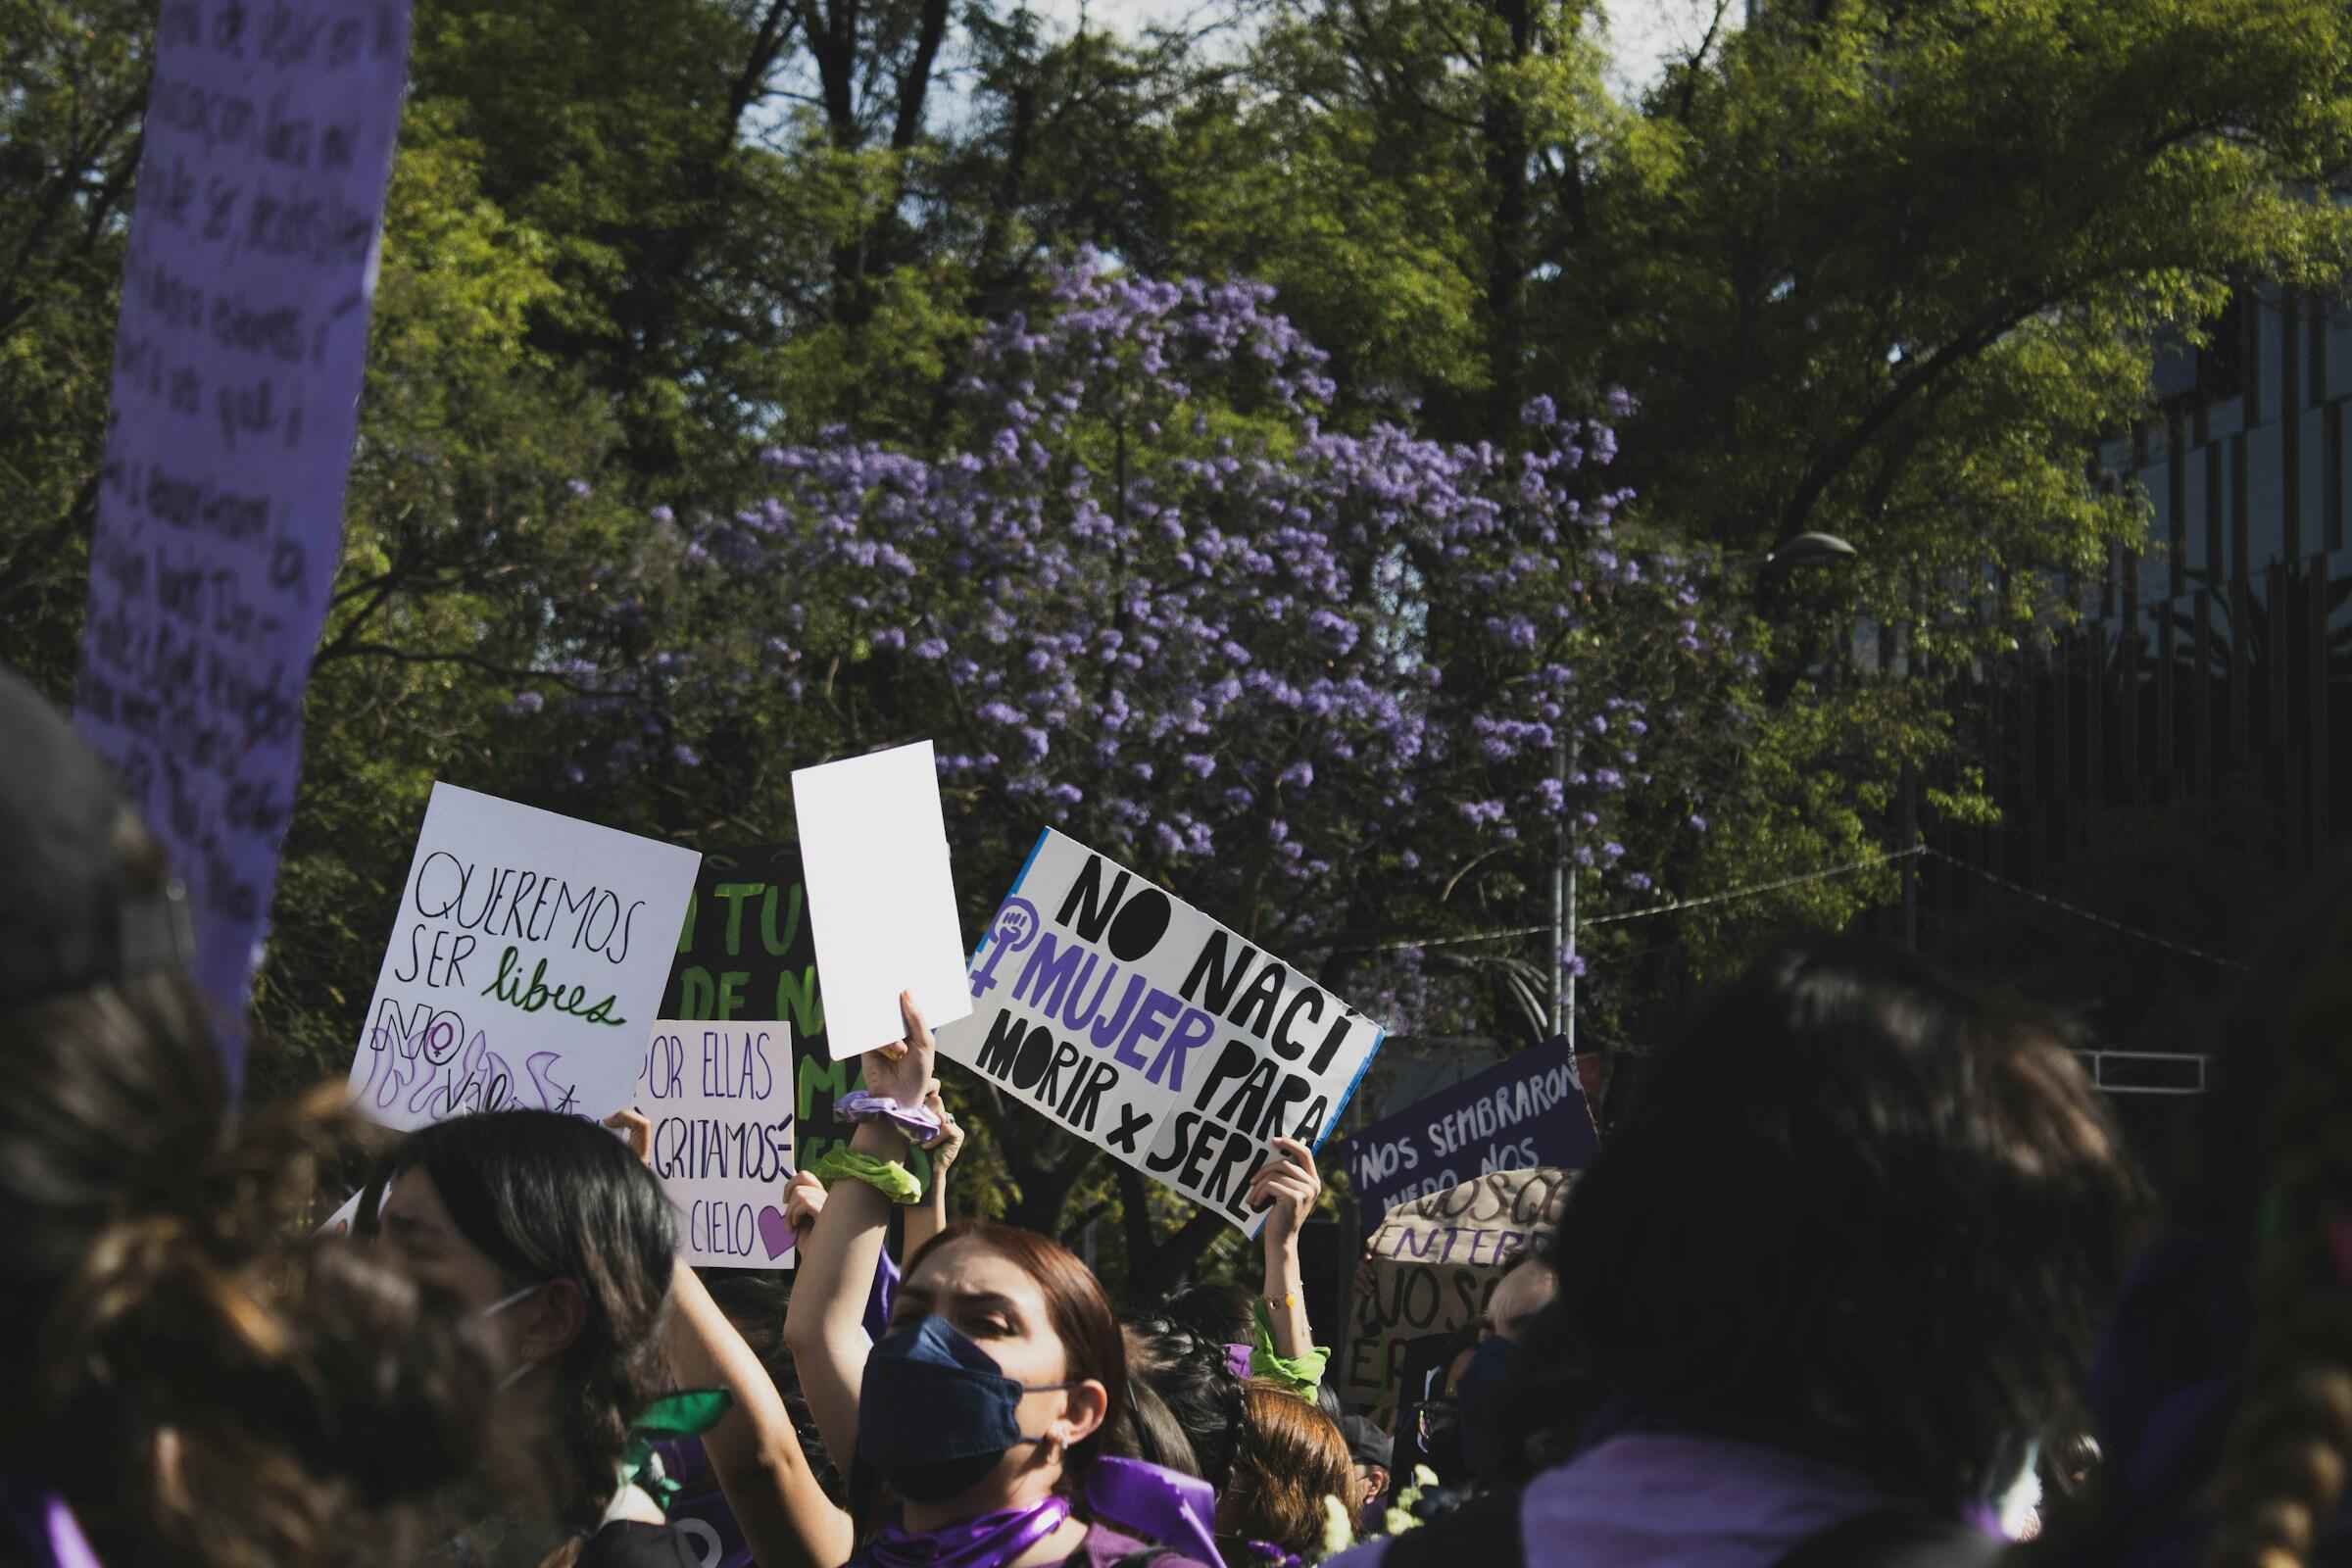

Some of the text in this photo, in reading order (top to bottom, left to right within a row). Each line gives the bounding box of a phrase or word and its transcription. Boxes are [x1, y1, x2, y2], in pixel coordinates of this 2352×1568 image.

[415, 851, 646, 964] QUEREMOS
[1055, 855, 1171, 962] NO
[394, 924, 628, 1027] SER libres
[369, 998, 466, 1066] NO
[639, 1032, 772, 1100] OR ELLAS
[1011, 932, 1328, 1156] MUJER PARA
[654, 1117, 780, 1183] GRITAMOS
[975, 1008, 1119, 1132] MORIR
[1146, 1111, 1277, 1223] SERL
[1428, 1063, 1583, 1157] SEMBRARON
[1482, 1136, 1540, 1176] NOS
[692, 1200, 755, 1256] CIELO
